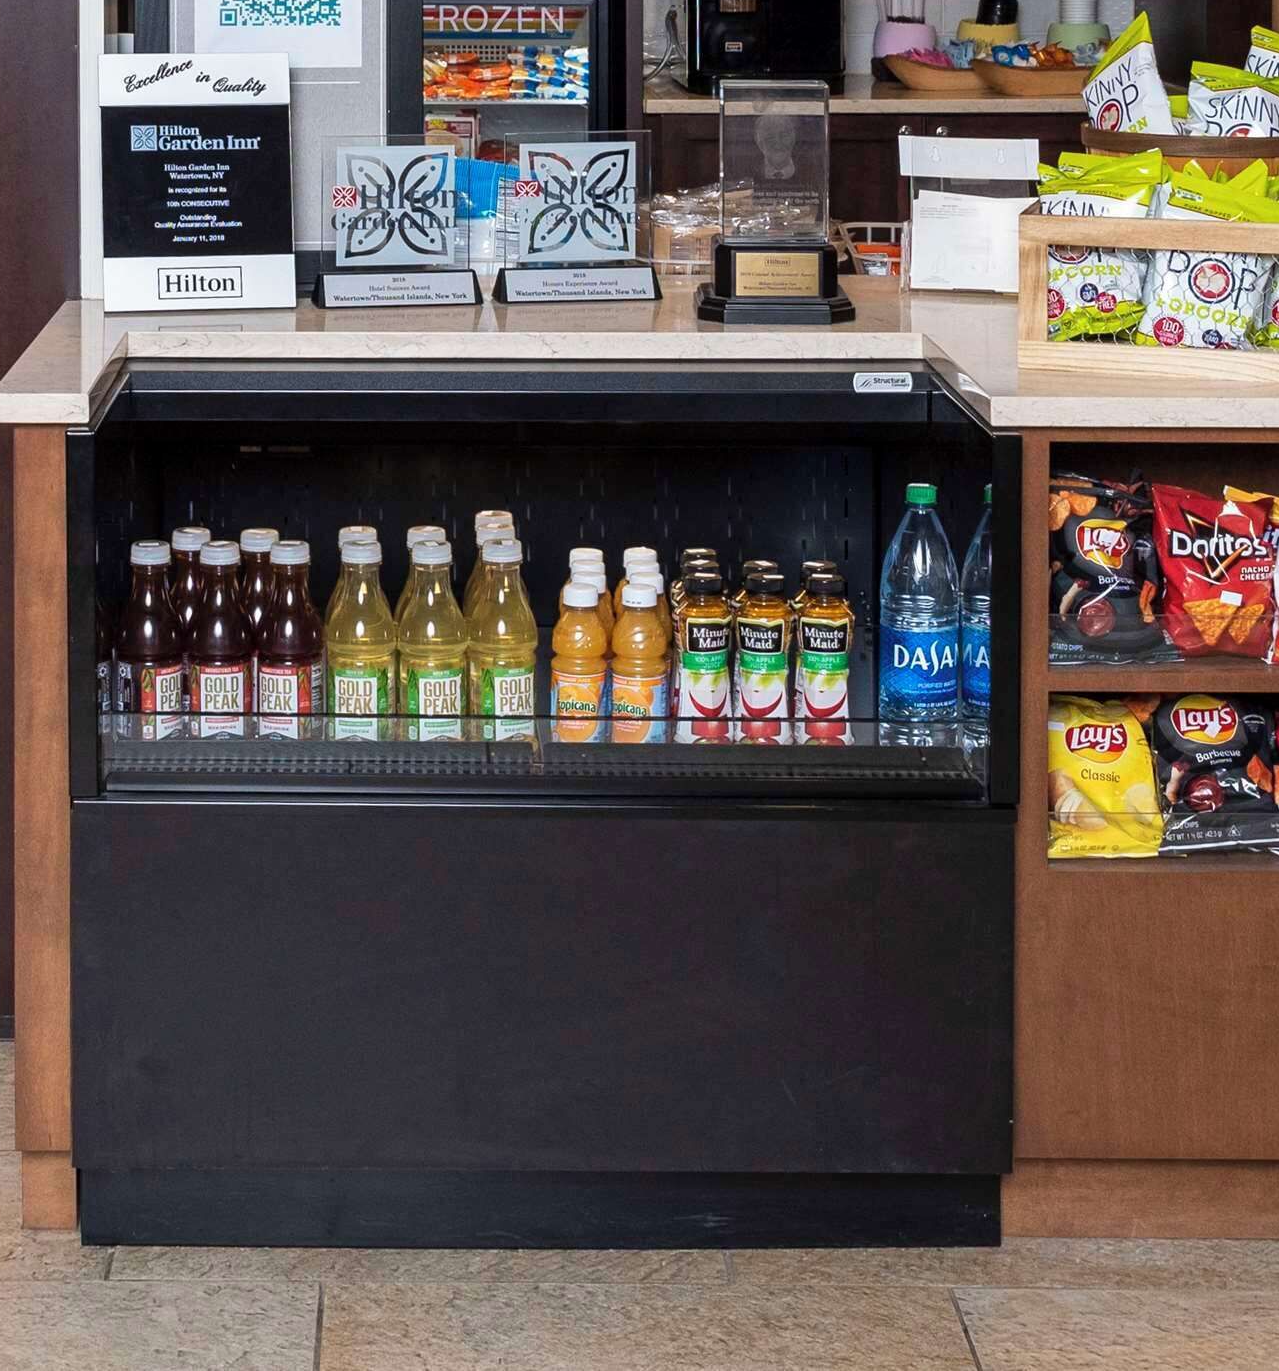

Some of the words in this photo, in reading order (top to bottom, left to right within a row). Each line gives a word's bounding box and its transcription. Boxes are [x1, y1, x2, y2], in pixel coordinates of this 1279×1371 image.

[422, 5, 565, 33] FROZEN
[123, 59, 193, 94] Excellence
[195, 71, 211, 84] in
[212, 77, 267, 97] Quality
[159, 125, 200, 136] Hilton
[158, 135, 225, 151] Garden
[226, 135, 259, 150] Inn
[170, 172, 211, 180] Watertown,
[361, 184, 458, 209] Hilton
[543, 179, 638, 204] Hilton
[1048, 264, 1122, 282] PCORN
[165, 274, 235, 293] Hilton
[1172, 530, 1267, 559] Doritos
[741, 627, 779, 639] Minute
[805, 627, 844, 639] Minute
[699, 637, 726, 649] Maid
[745, 638, 774, 649] Maid
[810, 638, 839, 649] Maid
[160, 677, 182, 694] GOL
[204, 676, 239, 694] GOLD
[261, 676, 292, 694] GOLD
[338, 679, 372, 696] GOLD
[423, 680, 457, 697] GOLD
[499, 678, 531, 696] GOLD
[160, 694, 181, 710] PEA
[204, 693, 240, 710] PEAK
[261, 694, 292, 711] PEAK
[338, 696, 373, 714] PEAK
[423, 696, 458, 714] PEAK
[499, 694, 533, 712] PEAK
[1178, 706, 1232, 732] Lay's
[1070, 724, 1124, 752] Lay's
[1195, 749, 1241, 763] Barbecue
[1081, 769, 1120, 783] Classic
